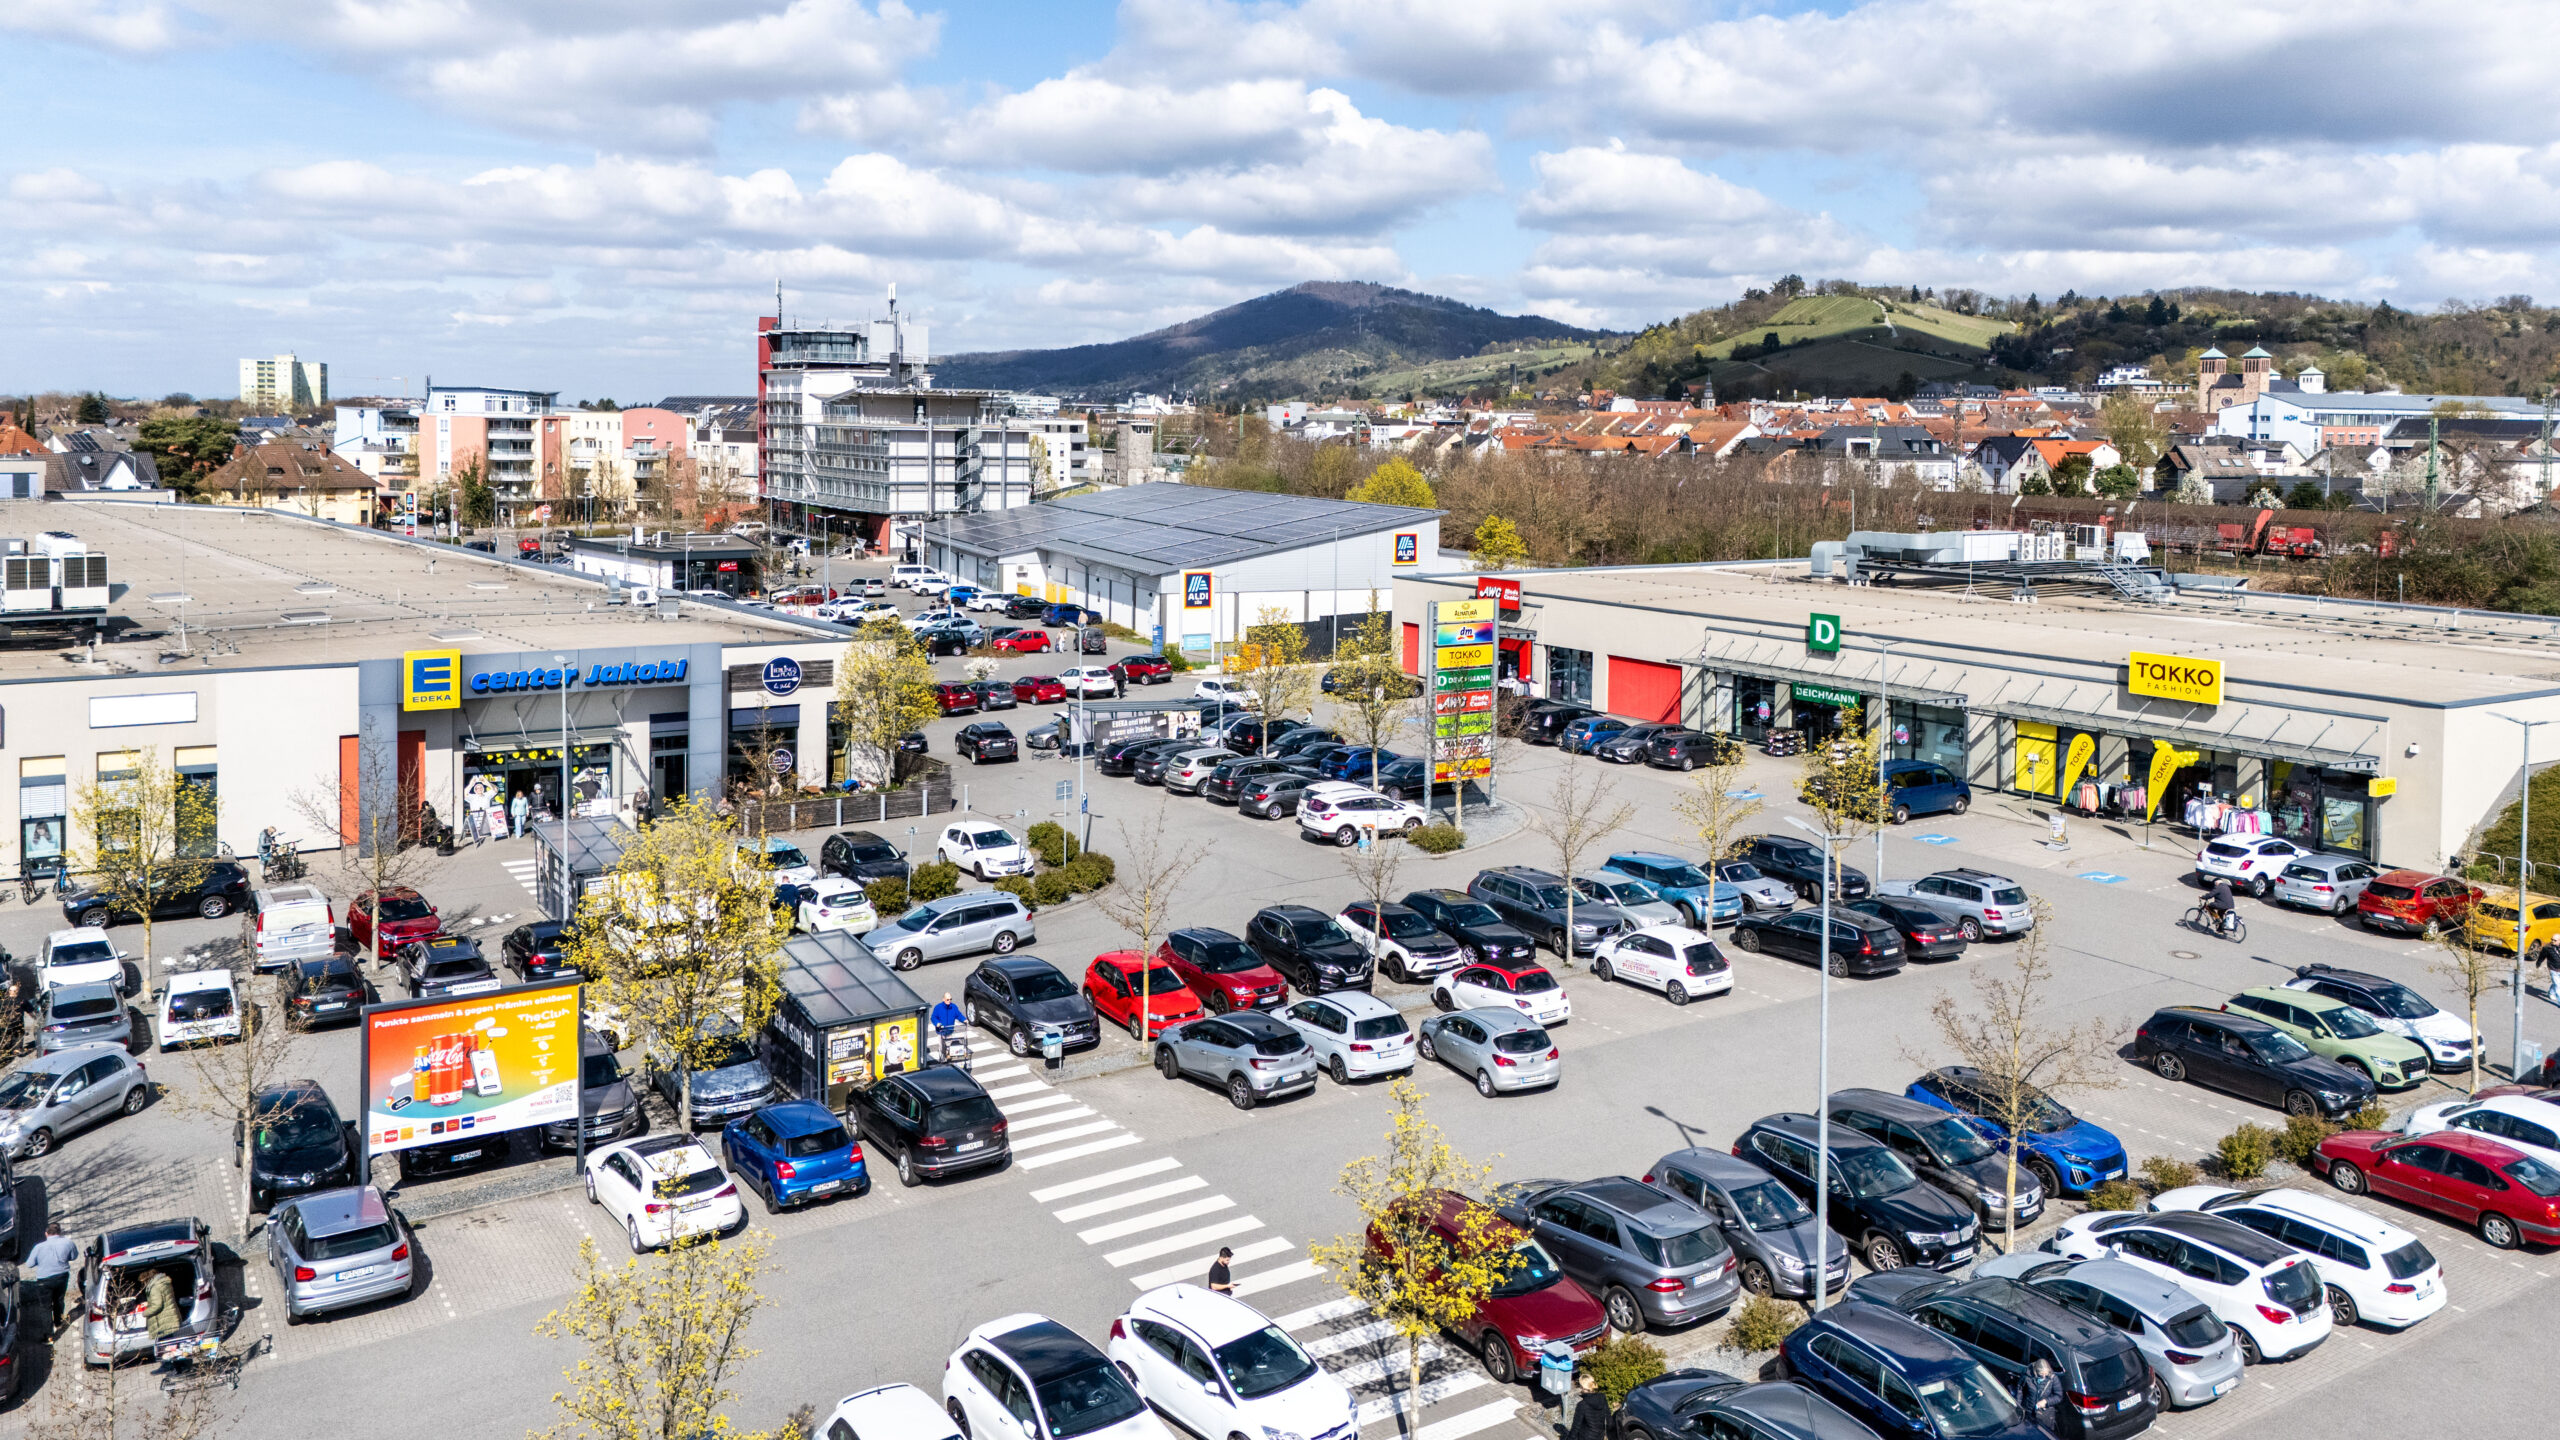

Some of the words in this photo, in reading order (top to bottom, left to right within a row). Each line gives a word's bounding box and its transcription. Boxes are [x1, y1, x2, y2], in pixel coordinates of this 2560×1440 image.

[1188, 592, 1209, 601] ALDI
[1479, 586, 1501, 598] AWG
[1460, 627, 1473, 636] dm
[1815, 619, 1835, 644] D
[471, 667, 579, 693] center
[584, 658, 688, 685] Jakobi
[1437, 675, 1447, 687] D
[1796, 687, 1855, 704] DEICHMANN
[2147, 682, 2202, 697] FASHION
[412, 694, 452, 704] EDEKA
[374, 1017, 409, 1029] Punkte
[410, 1011, 455, 1024] sammeln
[456, 1008, 463, 1017] &
[464, 1004, 494, 1018] gegen
[495, 1000, 534, 1012] Prämien
[832, 1040, 864, 1055] FRISCHEN
